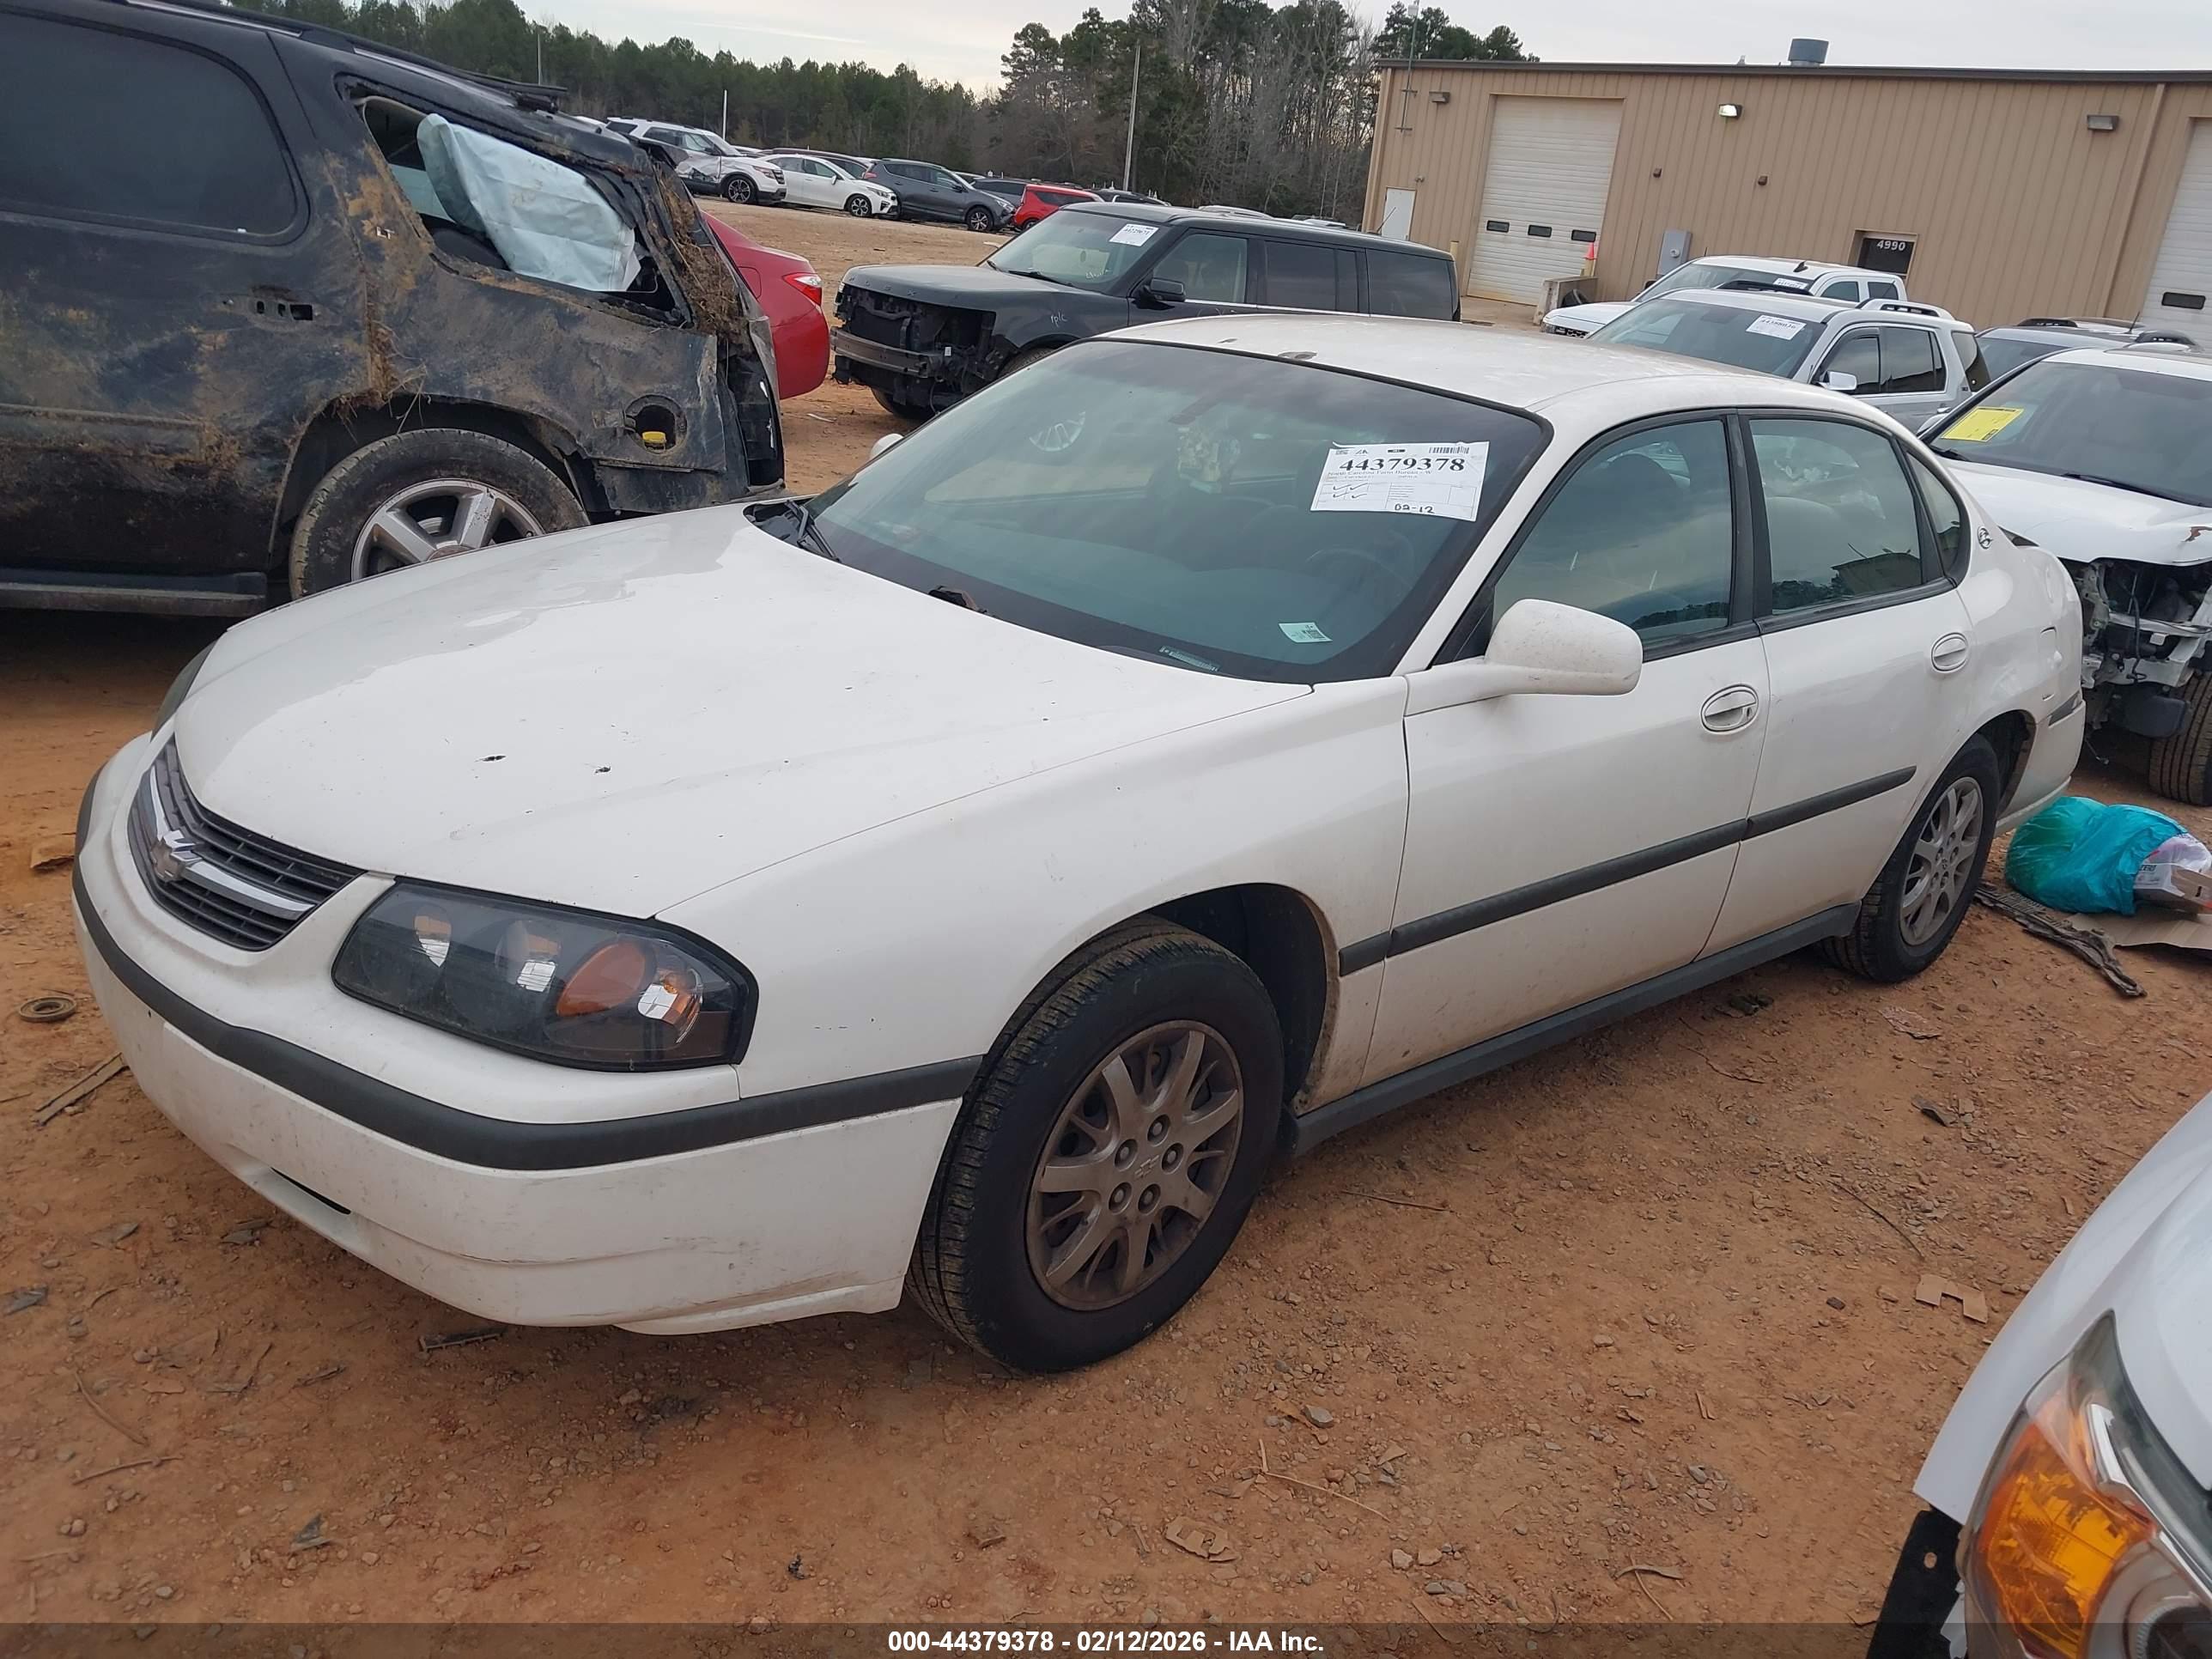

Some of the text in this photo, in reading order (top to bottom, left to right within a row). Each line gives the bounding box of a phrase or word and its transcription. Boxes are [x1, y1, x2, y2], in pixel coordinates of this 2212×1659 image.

[376, 226, 395, 240] LT
[1876, 240, 1906, 251] 4990
[1339, 458, 1465, 471] 44379378
[1395, 503, 1435, 514] 02-12
